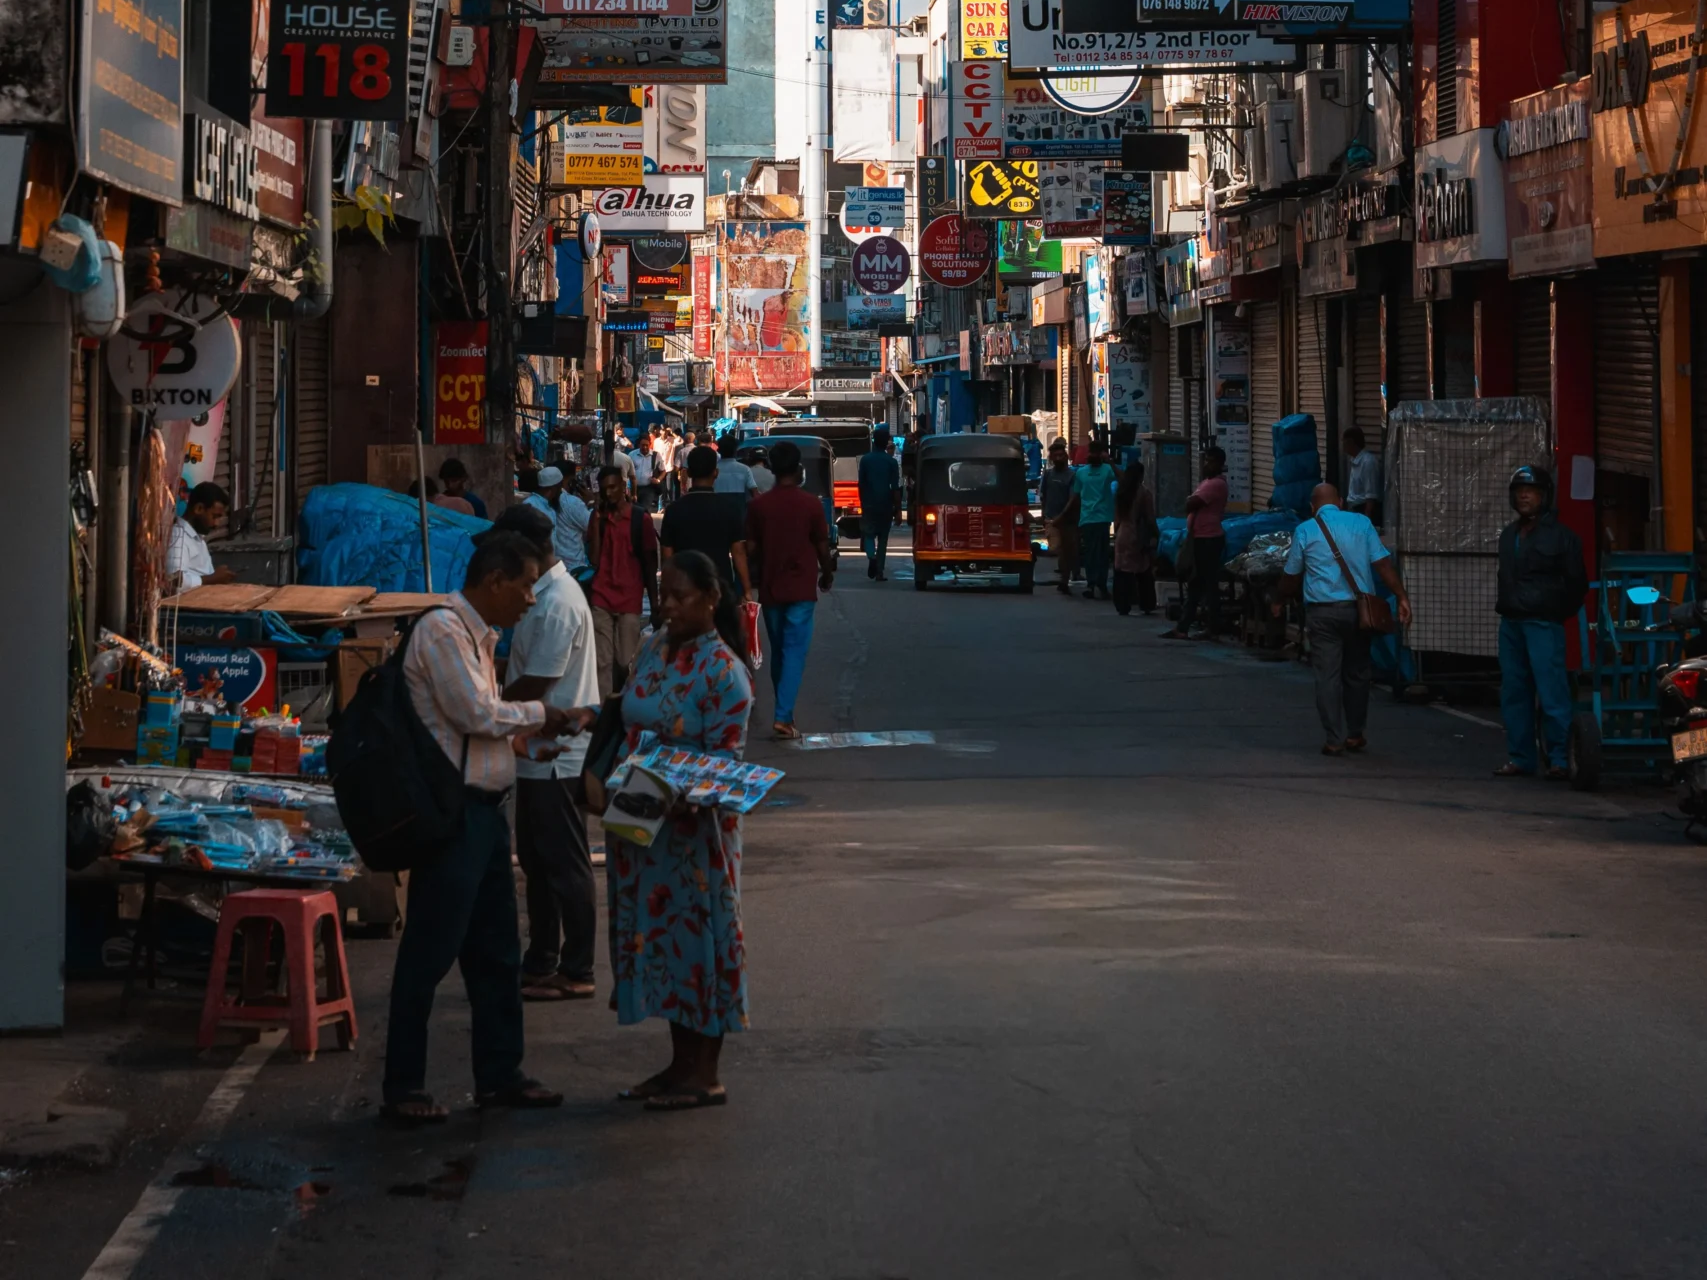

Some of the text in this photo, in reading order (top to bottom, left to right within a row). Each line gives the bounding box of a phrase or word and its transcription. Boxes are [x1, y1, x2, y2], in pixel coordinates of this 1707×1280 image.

[966, 3, 997, 17] SUN
[1243, 4, 1347, 20] HIKVISION
[285, 5, 397, 30] HOUSE
[644, 17, 719, 29] (PVT) LTD
[284, 27, 396, 40] CREATIVE RADIANCE
[966, 22, 998, 37] CAR
[1155, 30, 1250, 48] 2nd Floor
[281, 41, 392, 101] 118
[963, 63, 993, 138] CCTV
[955, 138, 1000, 148] HIKVISION
[568, 156, 639, 168] 0777 467 574
[649, 239, 683, 248] Mobile
[860, 254, 902, 272] MM
[923, 253, 954, 261] PHONE
[1031, 271, 1047, 279] STORM
[872, 280, 890, 291] 39
[819, 379, 848, 388] POLEK
[132, 387, 212, 406] BIXTON
[185, 653, 251, 665] Highland Red
[222, 666, 250, 678] Apple
